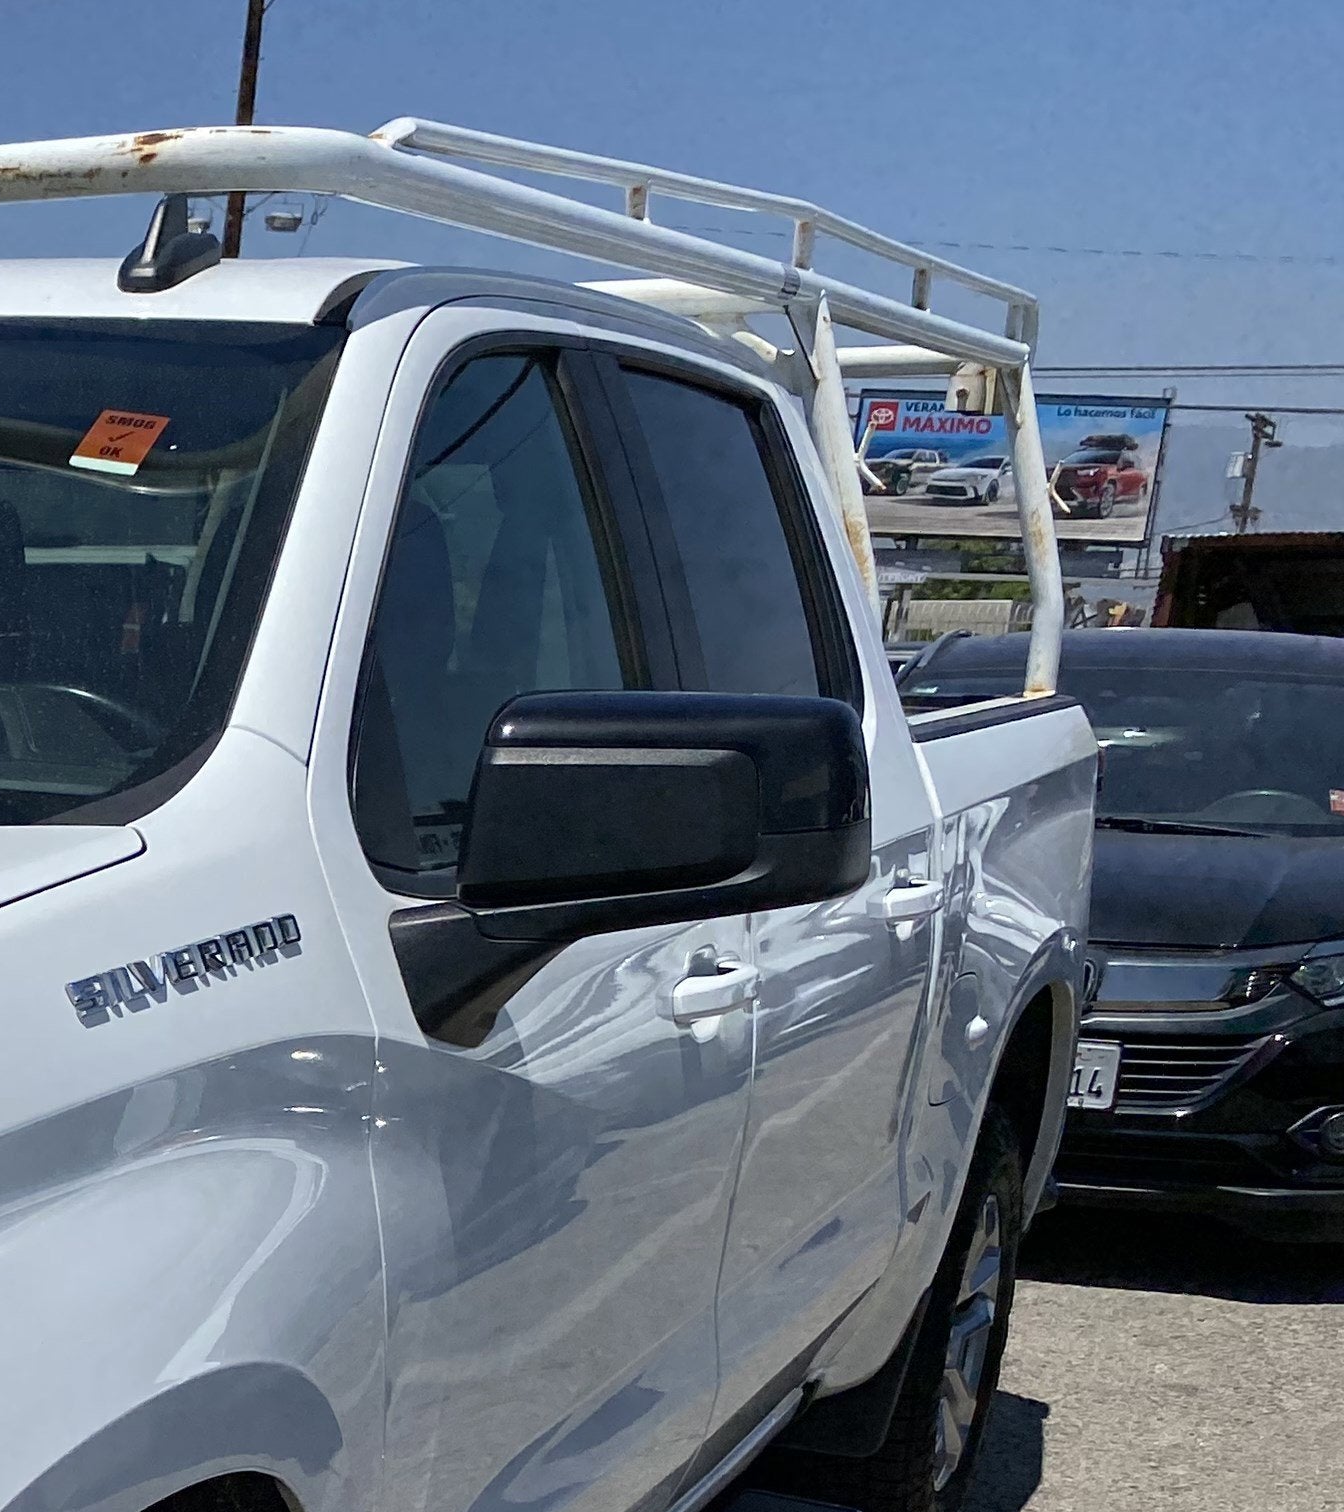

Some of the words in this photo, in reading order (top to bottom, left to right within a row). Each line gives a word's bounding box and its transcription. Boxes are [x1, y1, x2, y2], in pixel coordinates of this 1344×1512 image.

[906, 401, 945, 412] VERAN
[1057, 406, 1071, 417] Lo
[105, 415, 157, 430] SMOG
[902, 411, 993, 435] MÁXIMO
[99, 445, 124, 458] OK
[65, 913, 302, 1018] SILVERADO
